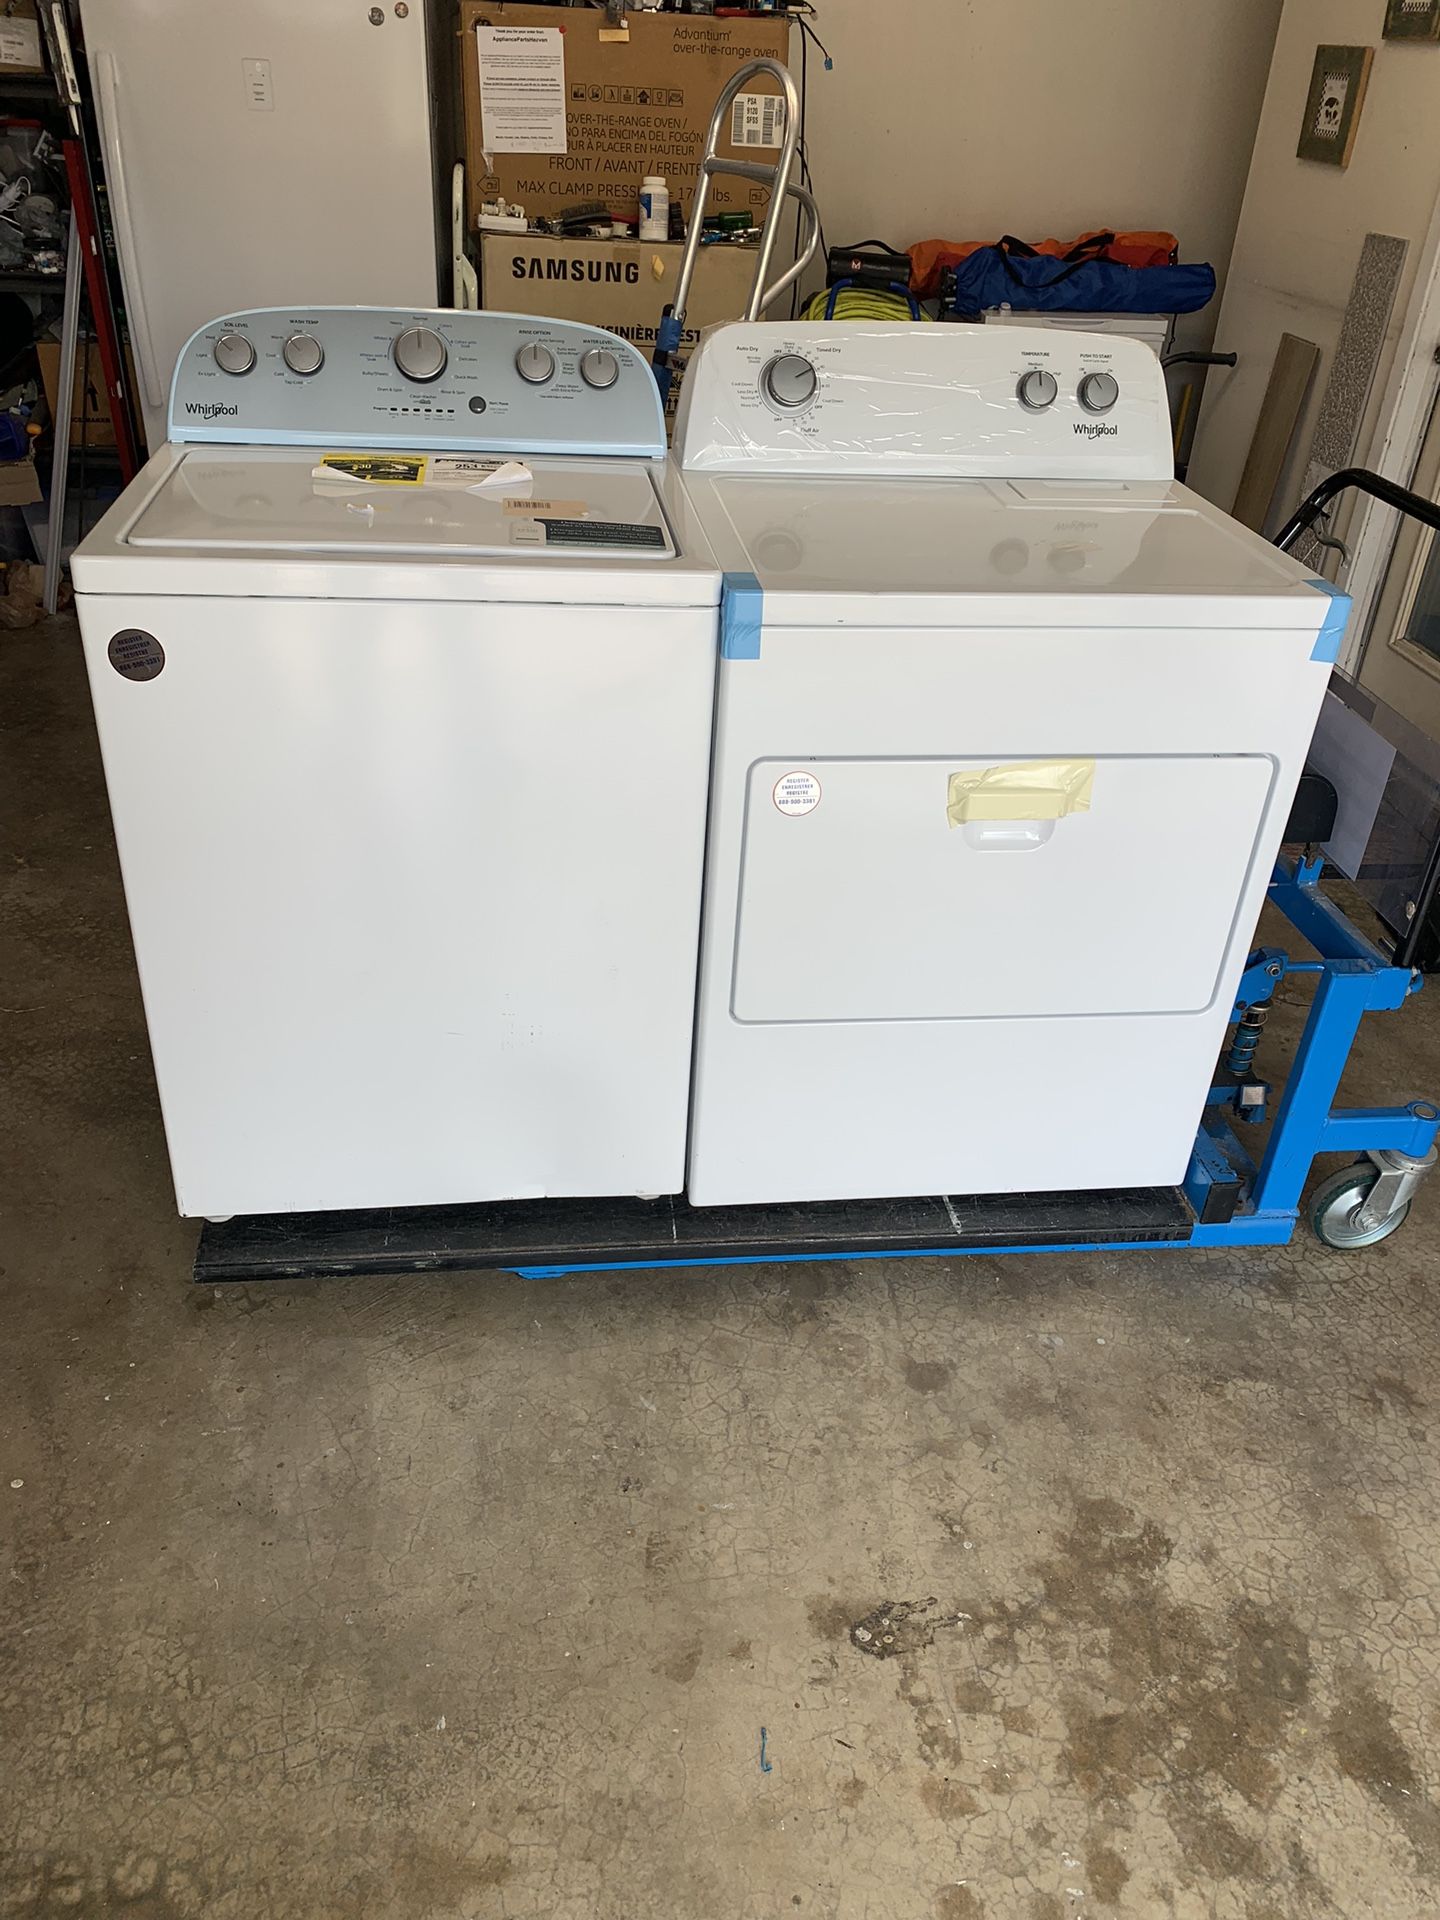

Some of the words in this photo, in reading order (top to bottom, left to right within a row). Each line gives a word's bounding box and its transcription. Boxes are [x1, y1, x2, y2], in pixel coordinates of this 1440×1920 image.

[674, 28, 730, 40] Advantium
[673, 43, 751, 59] over-the-range
[754, 48, 778, 58] oven
[566, 112, 652, 128] OVER-THE-RANGE
[654, 118, 680, 128] OVEN
[582, 127, 606, 138] PARA
[609, 129, 646, 140] ENCIMA
[648, 130, 666, 140] DEL
[669, 130, 704, 143] FOGÓN
[587, 138, 594, 151] À
[596, 142, 632, 153] PLACER
[635, 143, 647, 153] EN
[650, 144, 694, 156] HAUTEUR
[549, 157, 592, 171] FRONT
[595, 158, 600, 172] /
[604, 160, 644, 173] AVANT
[647, 160, 654, 174] /
[656, 161, 701, 176] FRENTE
[517, 180, 545, 193] MAX
[549, 182, 593, 195] CLAMP
[713, 188, 733, 202] lbs.
[512, 256, 639, 284] SAMSUNG
[186, 402, 238, 419] Whirlpool
[1073, 423, 1117, 440] Whirlpool
